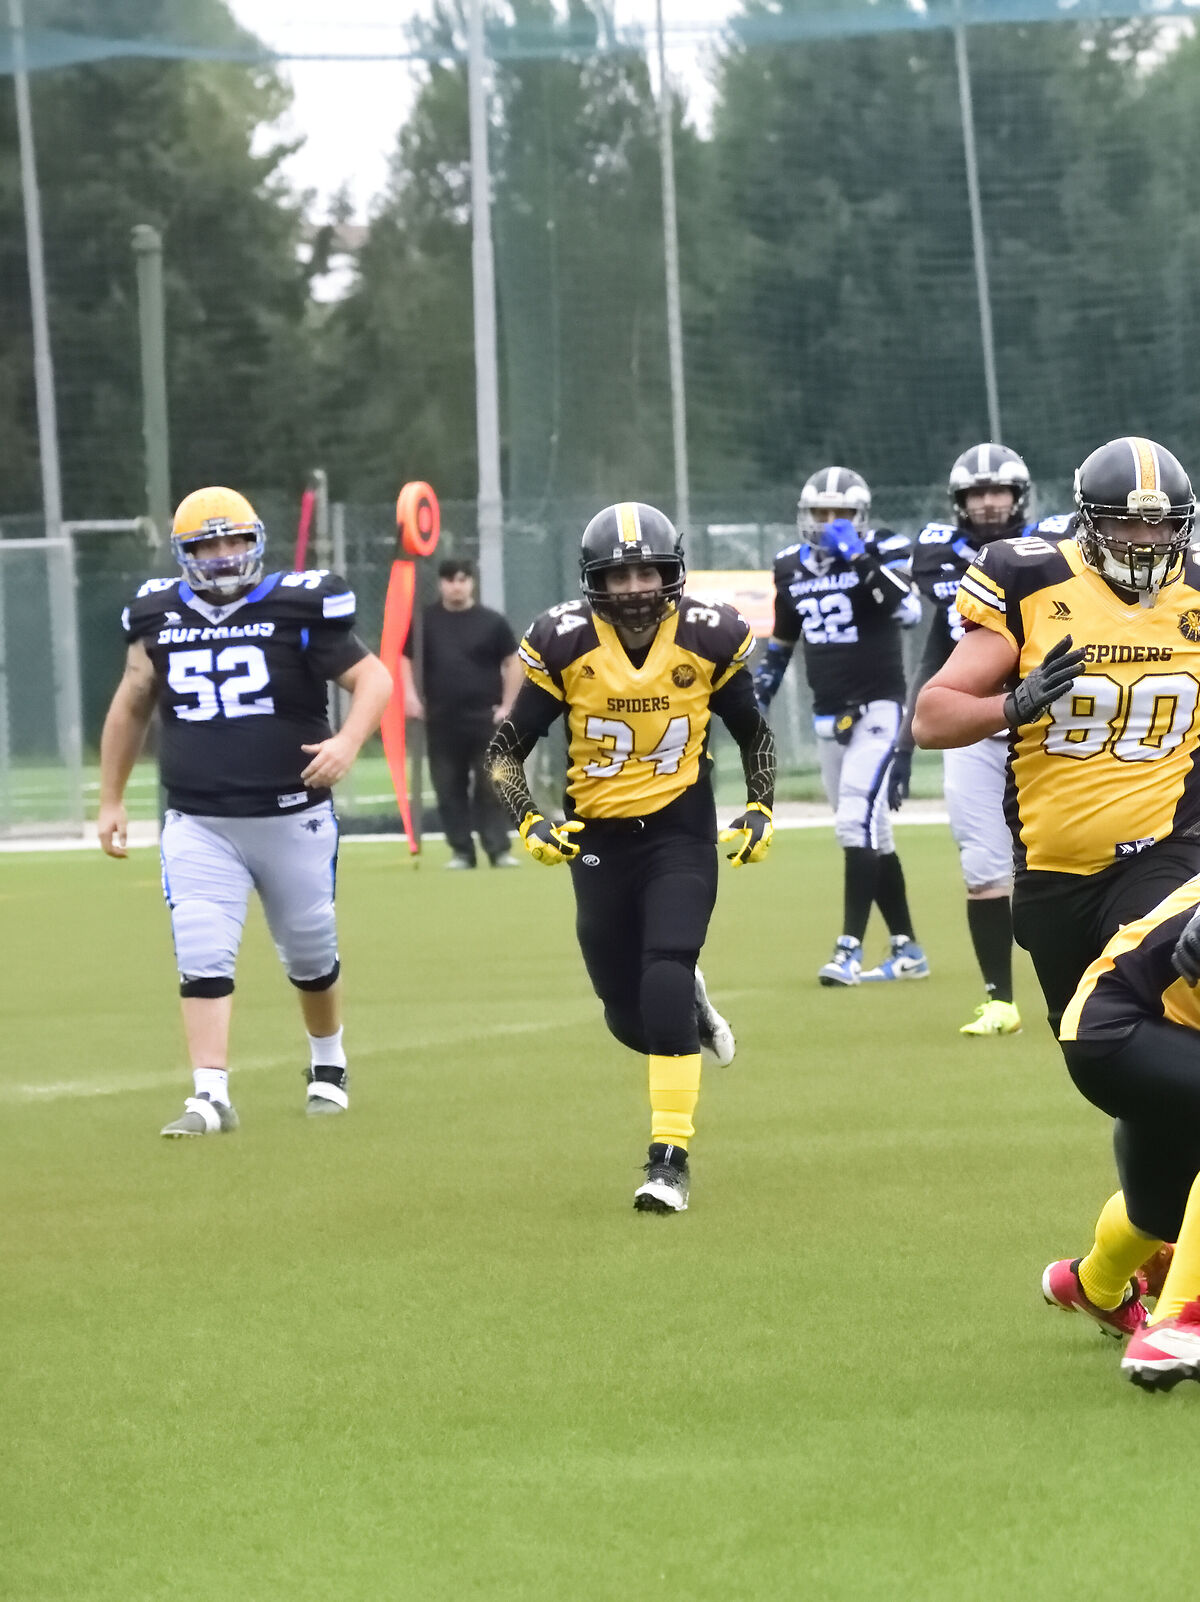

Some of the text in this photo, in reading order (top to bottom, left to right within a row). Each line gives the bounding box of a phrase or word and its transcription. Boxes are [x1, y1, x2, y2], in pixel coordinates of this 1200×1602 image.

[795, 592, 859, 644] 22
[167, 645, 276, 721] 52
[1083, 644, 1173, 664] SPIDERS
[607, 695, 670, 713] SPIDERS
[1039, 671, 1200, 763] 80
[581, 713, 691, 778] 34
